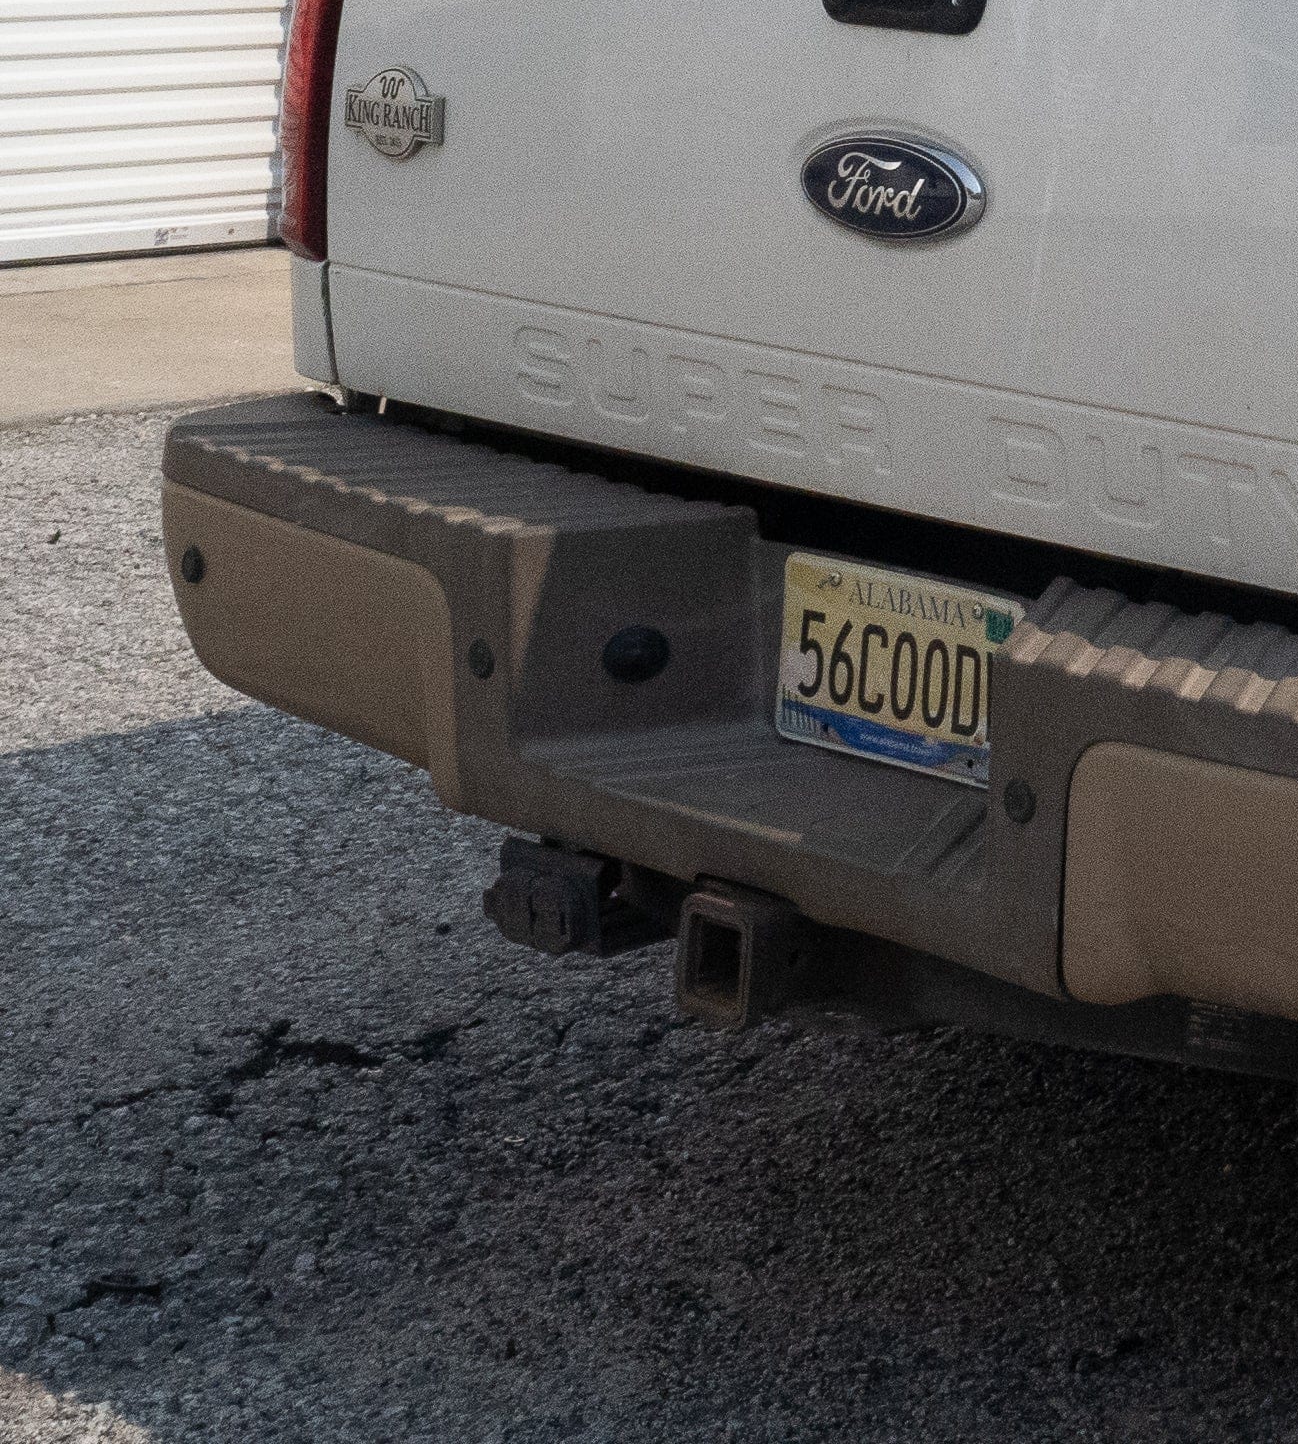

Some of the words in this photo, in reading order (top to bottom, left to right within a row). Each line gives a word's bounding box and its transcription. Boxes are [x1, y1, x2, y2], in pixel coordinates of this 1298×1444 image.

[347, 93, 380, 126] KING
[383, 102, 432, 133] RANCH
[827, 151, 926, 221] Ford
[513, 323, 894, 477] SUPER
[849, 581, 966, 629] ALABAMA
